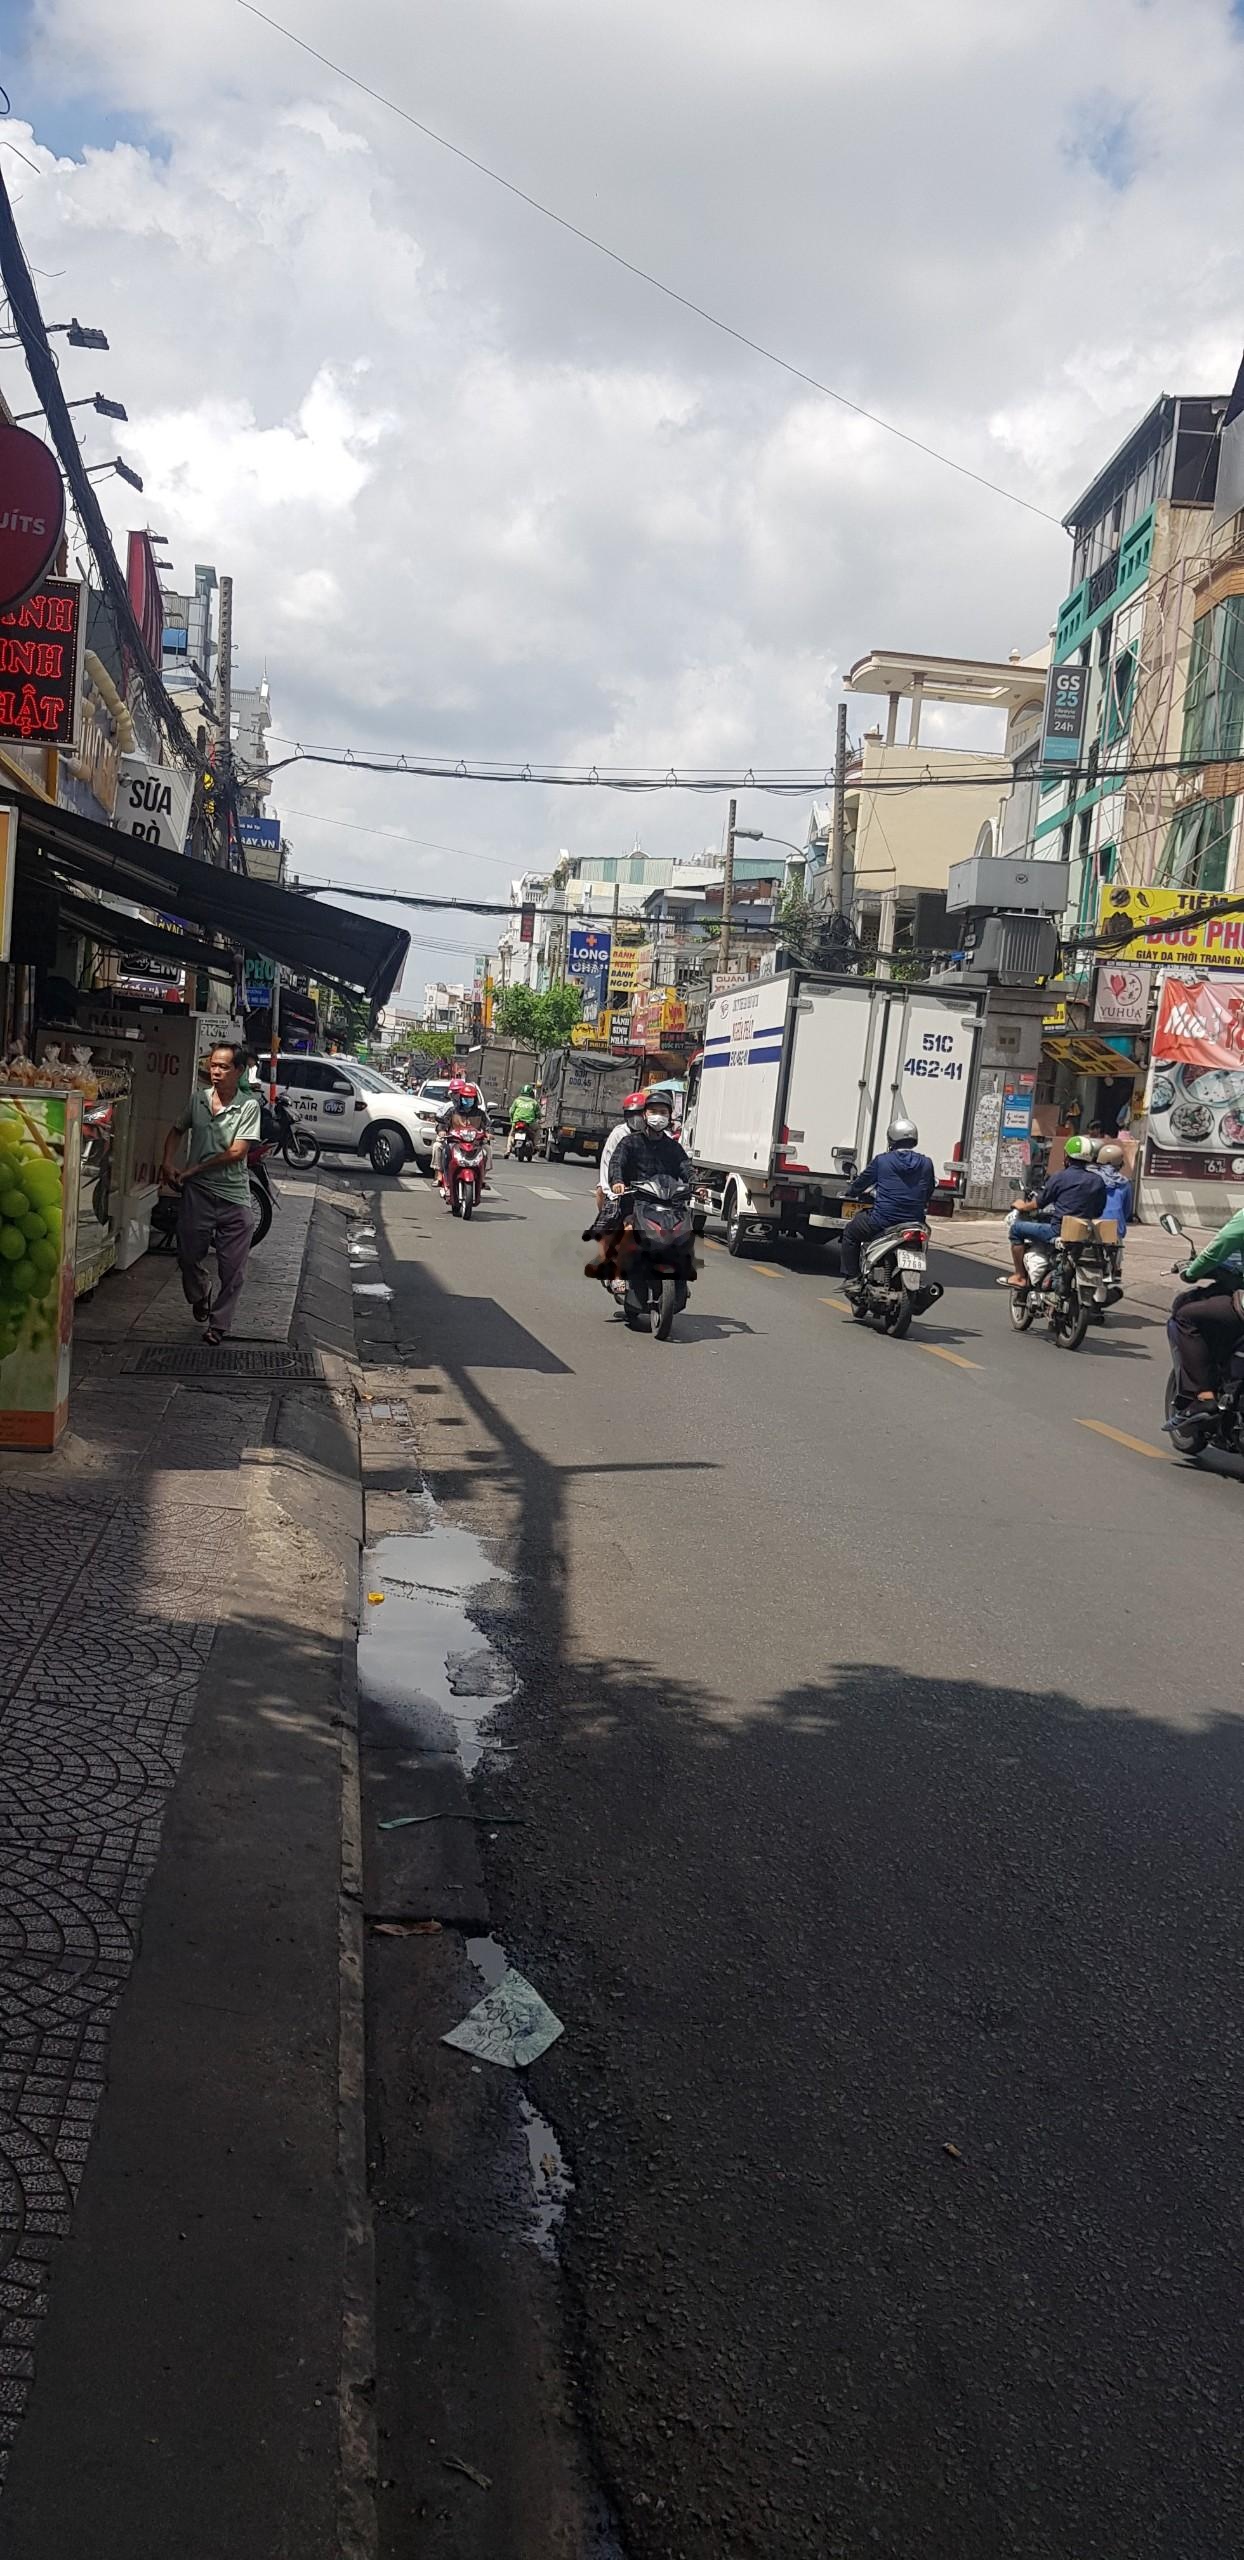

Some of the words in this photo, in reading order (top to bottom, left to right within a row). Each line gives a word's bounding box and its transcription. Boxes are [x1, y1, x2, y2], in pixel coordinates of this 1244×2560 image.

[1056, 674, 1080, 691] GS
[1055, 690, 1079, 707] 25
[1053, 721, 1074, 732] 24h
[129, 776, 172, 815] SỮA
[573, 948, 608, 960] LONG
[1161, 951, 1173, 961] DA
[1200, 954, 1231, 965] TRANG
[923, 1034, 953, 1053] 51C
[289, 1101, 318, 1111] TAIR
[325, 1103, 345, 1112] GWS
